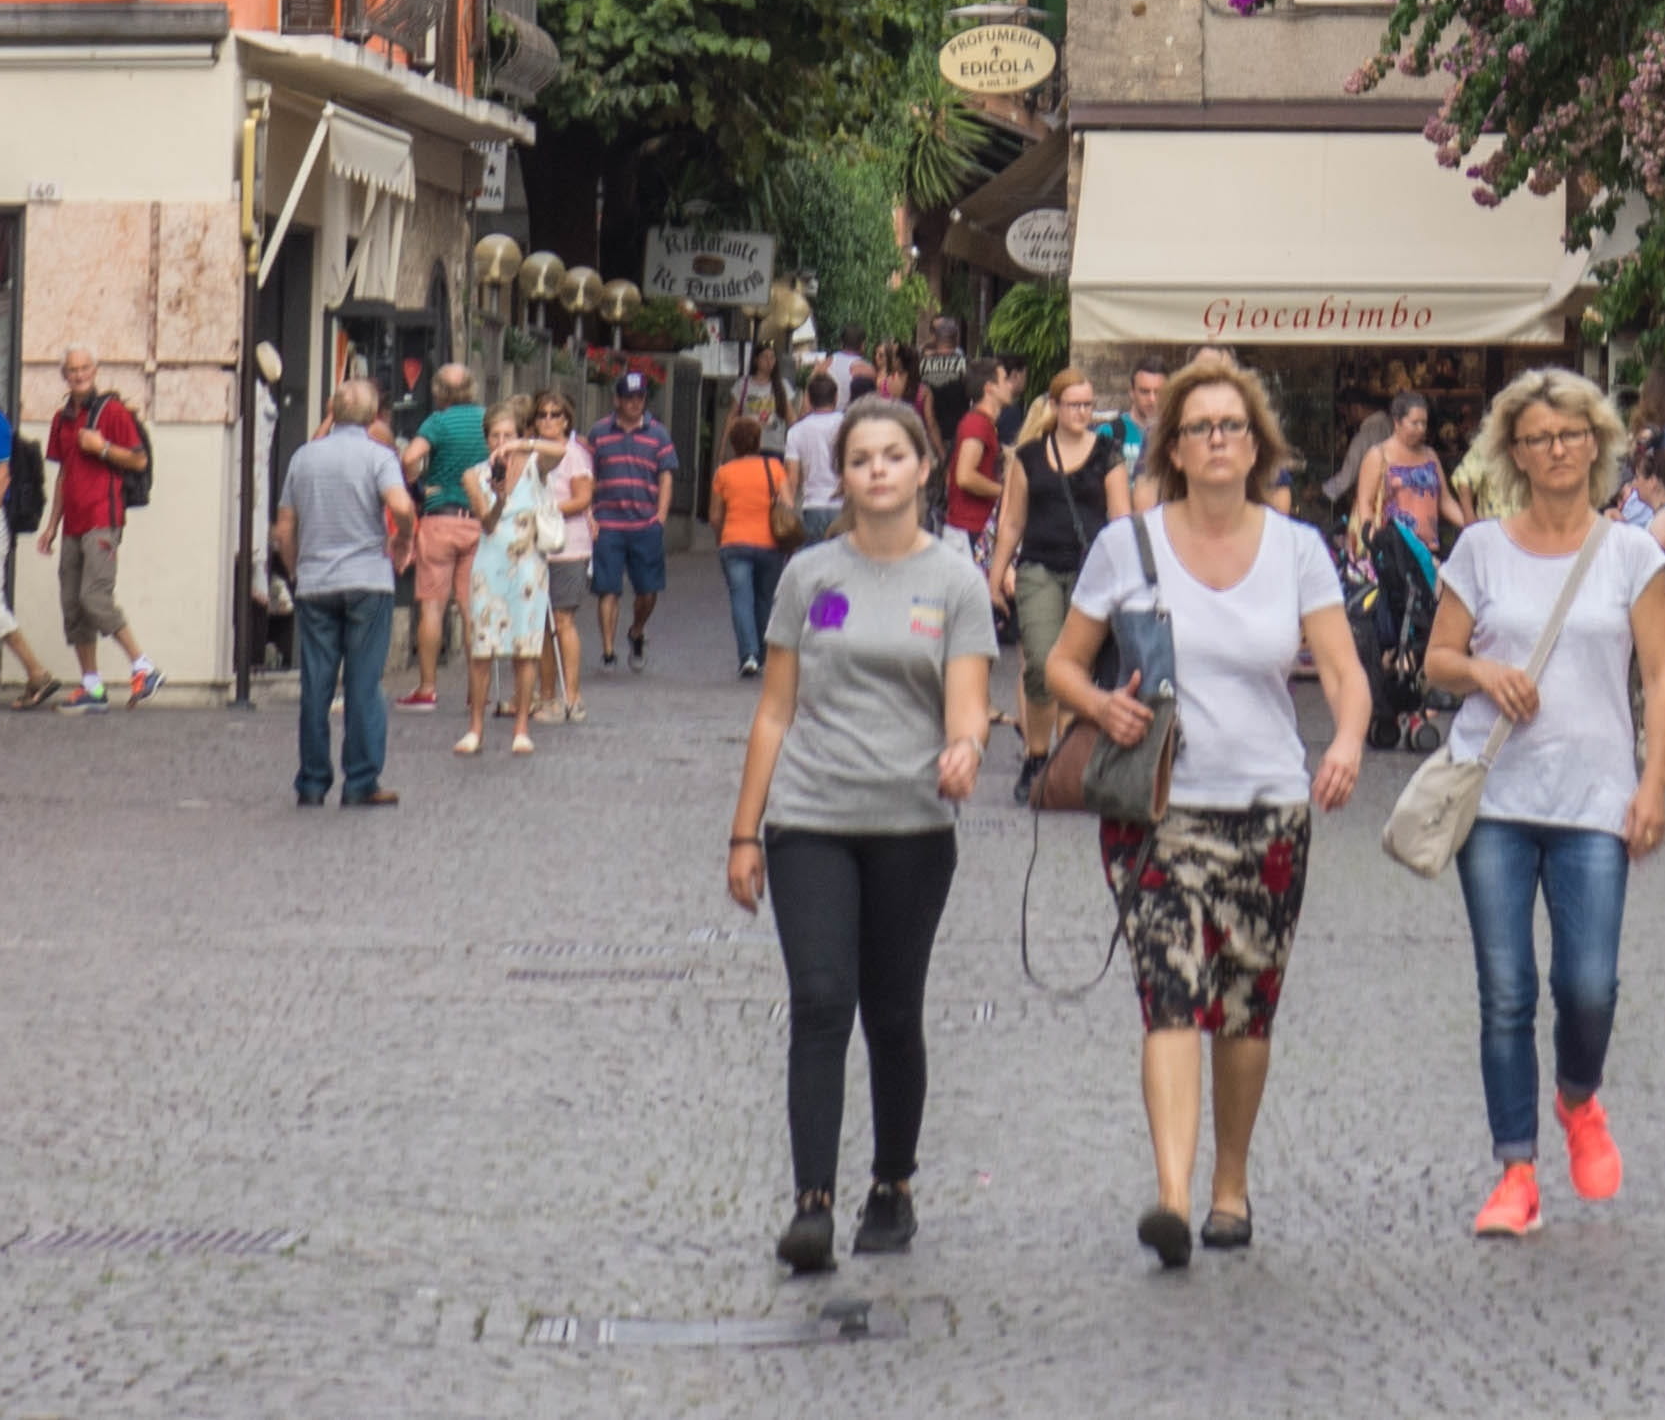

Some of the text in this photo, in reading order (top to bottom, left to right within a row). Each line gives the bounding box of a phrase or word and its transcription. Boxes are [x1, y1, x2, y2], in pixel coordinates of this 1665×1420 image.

[947, 28, 1042, 56] PROFUMERIA
[959, 58, 1035, 77] EDICOLA
[661, 234, 759, 263] Ristorante
[1203, 294, 1433, 336] Giocabimbo
